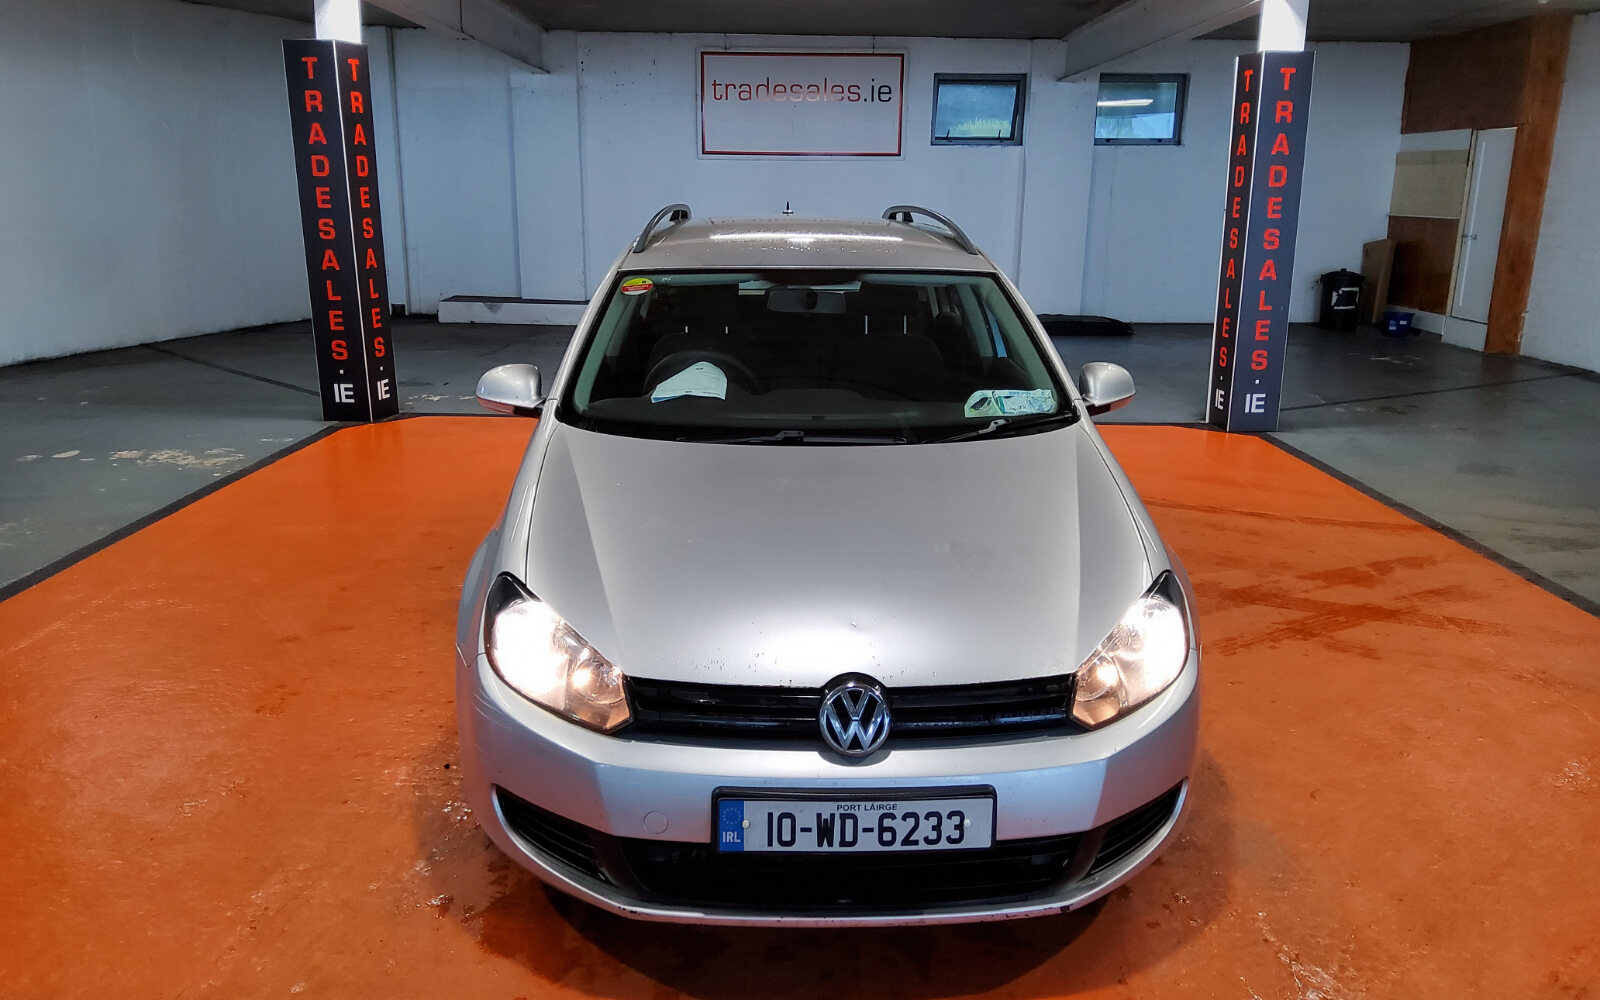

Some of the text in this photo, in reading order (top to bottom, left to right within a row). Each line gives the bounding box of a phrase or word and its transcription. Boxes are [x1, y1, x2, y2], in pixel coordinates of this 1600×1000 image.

[711, 77, 892, 103] tradesales.ie
[837, 804, 861, 812] PORT
[722, 831, 742, 843] IRL
[767, 810, 966, 848] 10-WD-6233
